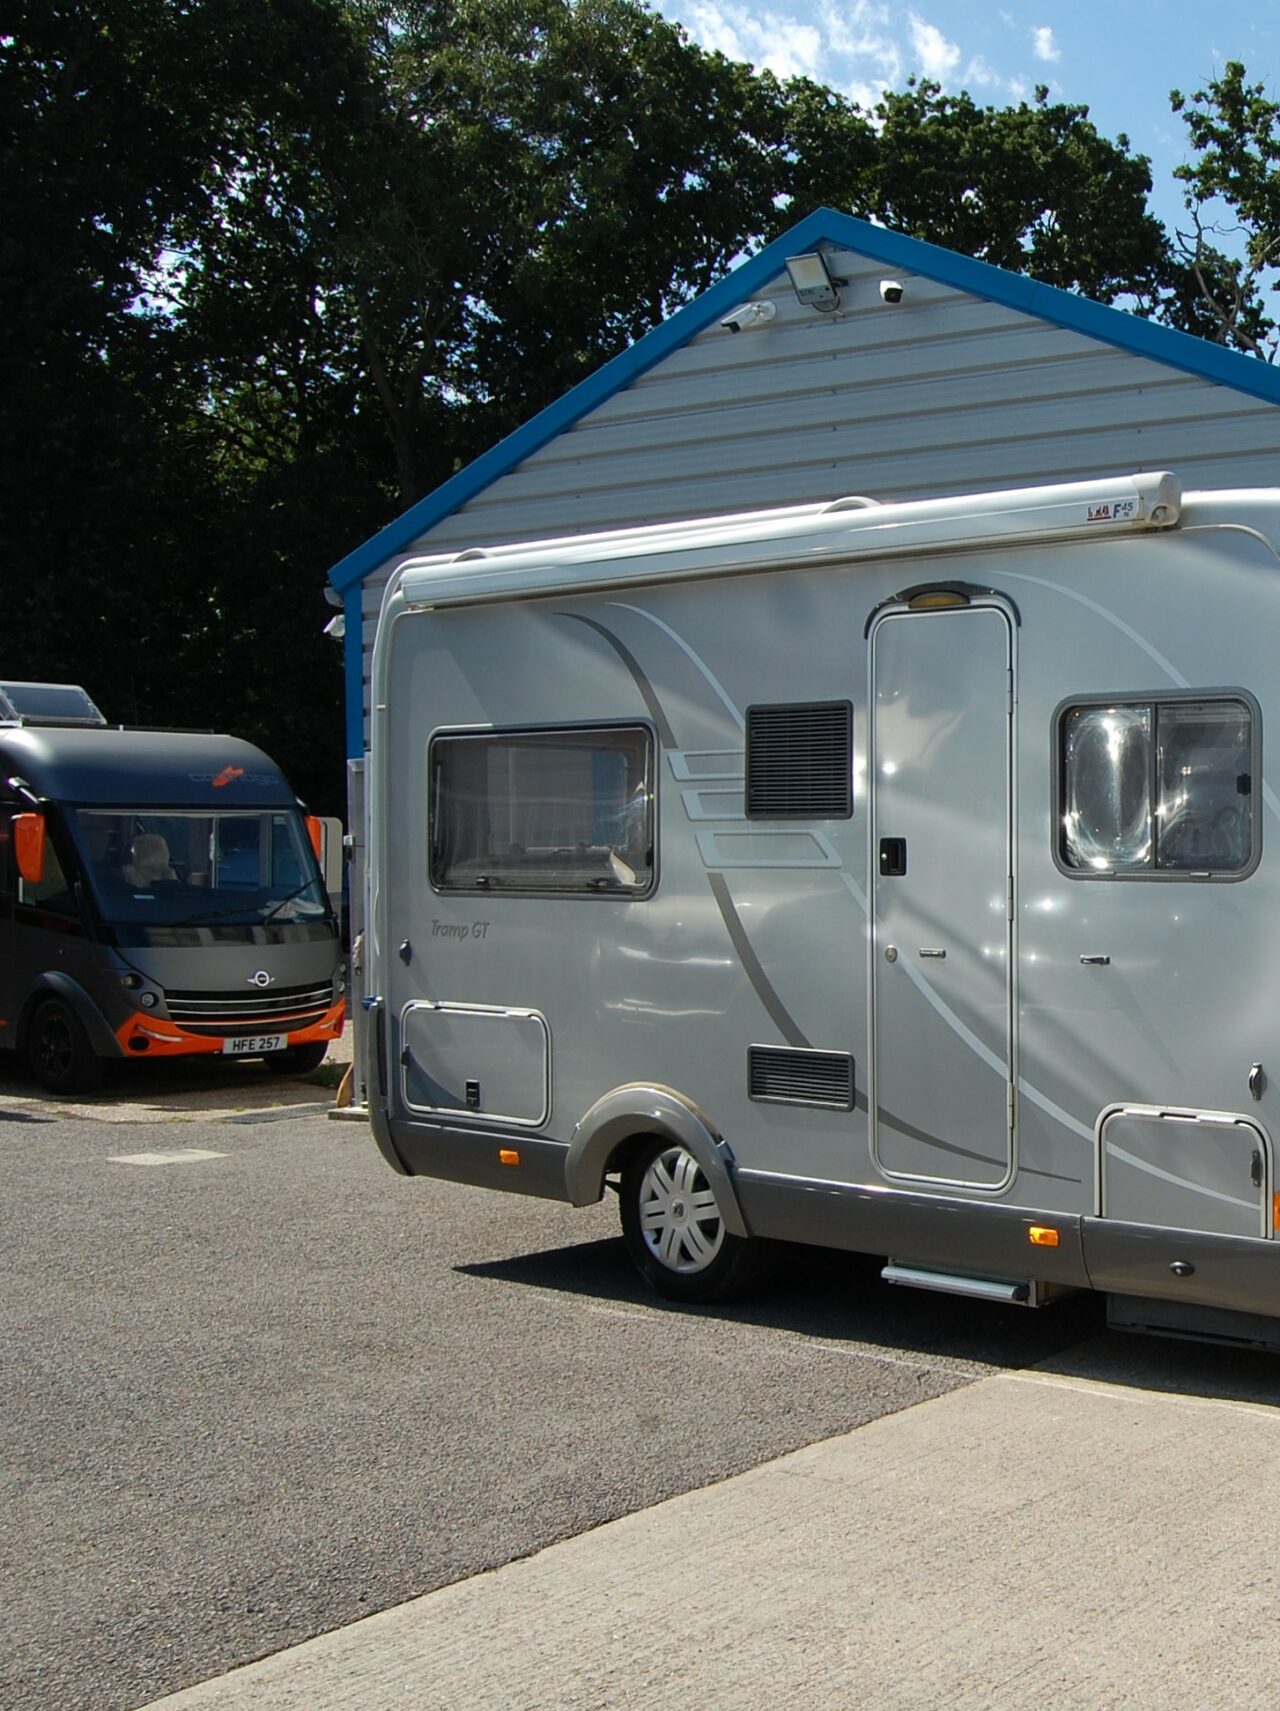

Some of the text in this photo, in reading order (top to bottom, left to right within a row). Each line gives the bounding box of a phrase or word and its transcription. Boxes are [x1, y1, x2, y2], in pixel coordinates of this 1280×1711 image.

[431, 919, 490, 942] Tramp GT
[232, 1037, 280, 1051] HFE 257
